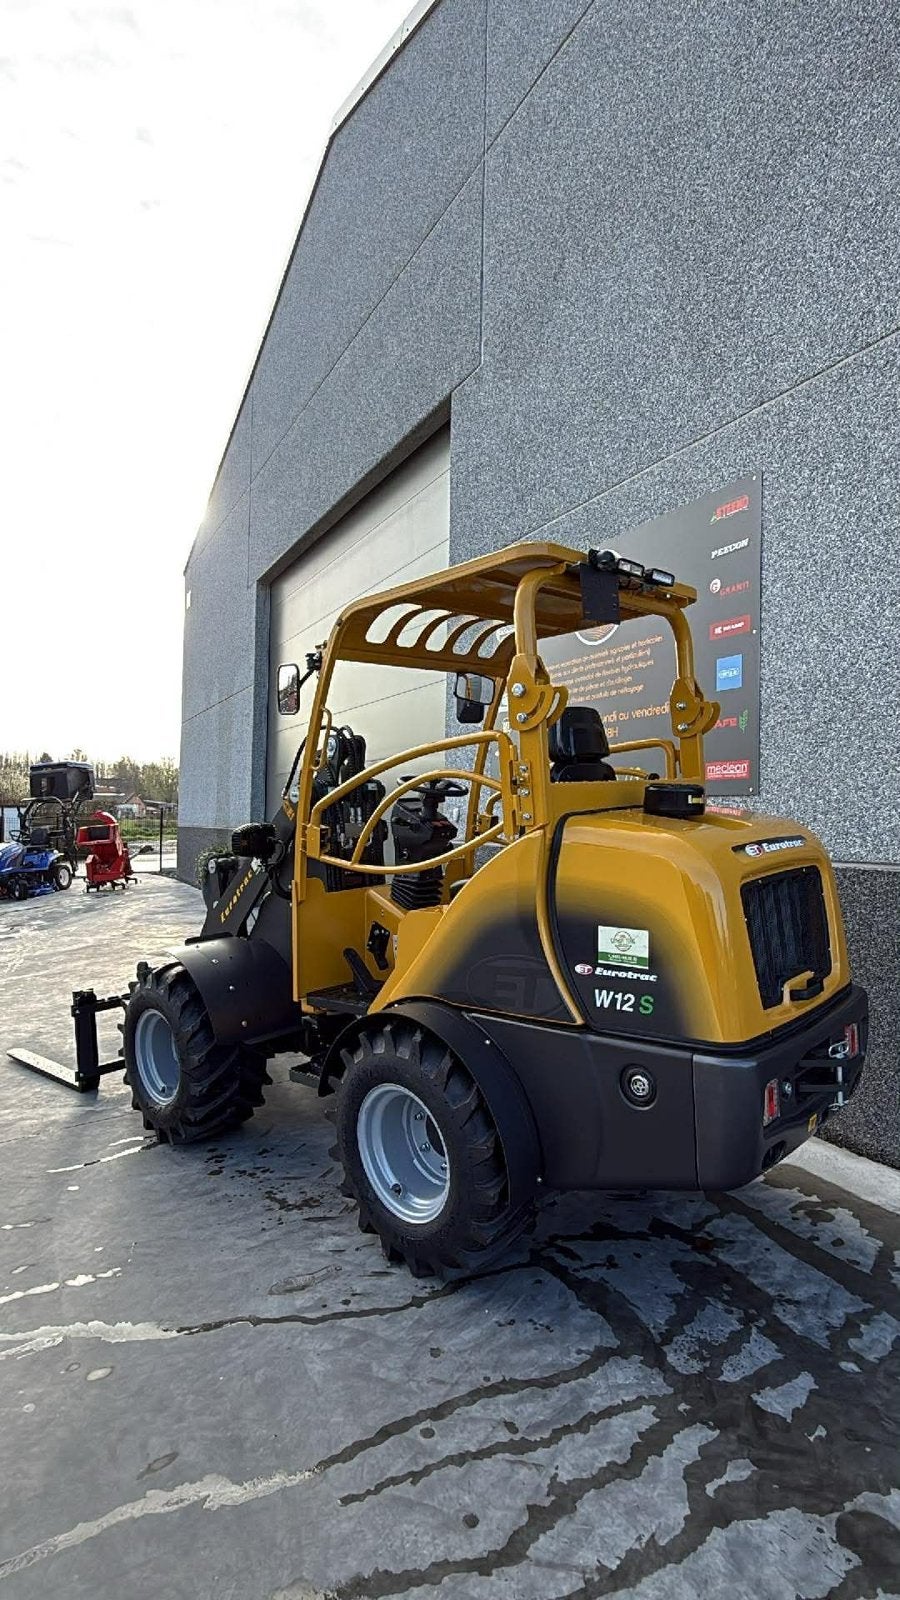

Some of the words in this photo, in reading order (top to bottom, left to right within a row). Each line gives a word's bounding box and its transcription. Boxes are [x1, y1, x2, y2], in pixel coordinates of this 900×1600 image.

[762, 839, 805, 853] Eurotrac
[594, 967, 658, 982] Eurotrac
[594, 988, 636, 1012] W12
[639, 995, 655, 1014] S
